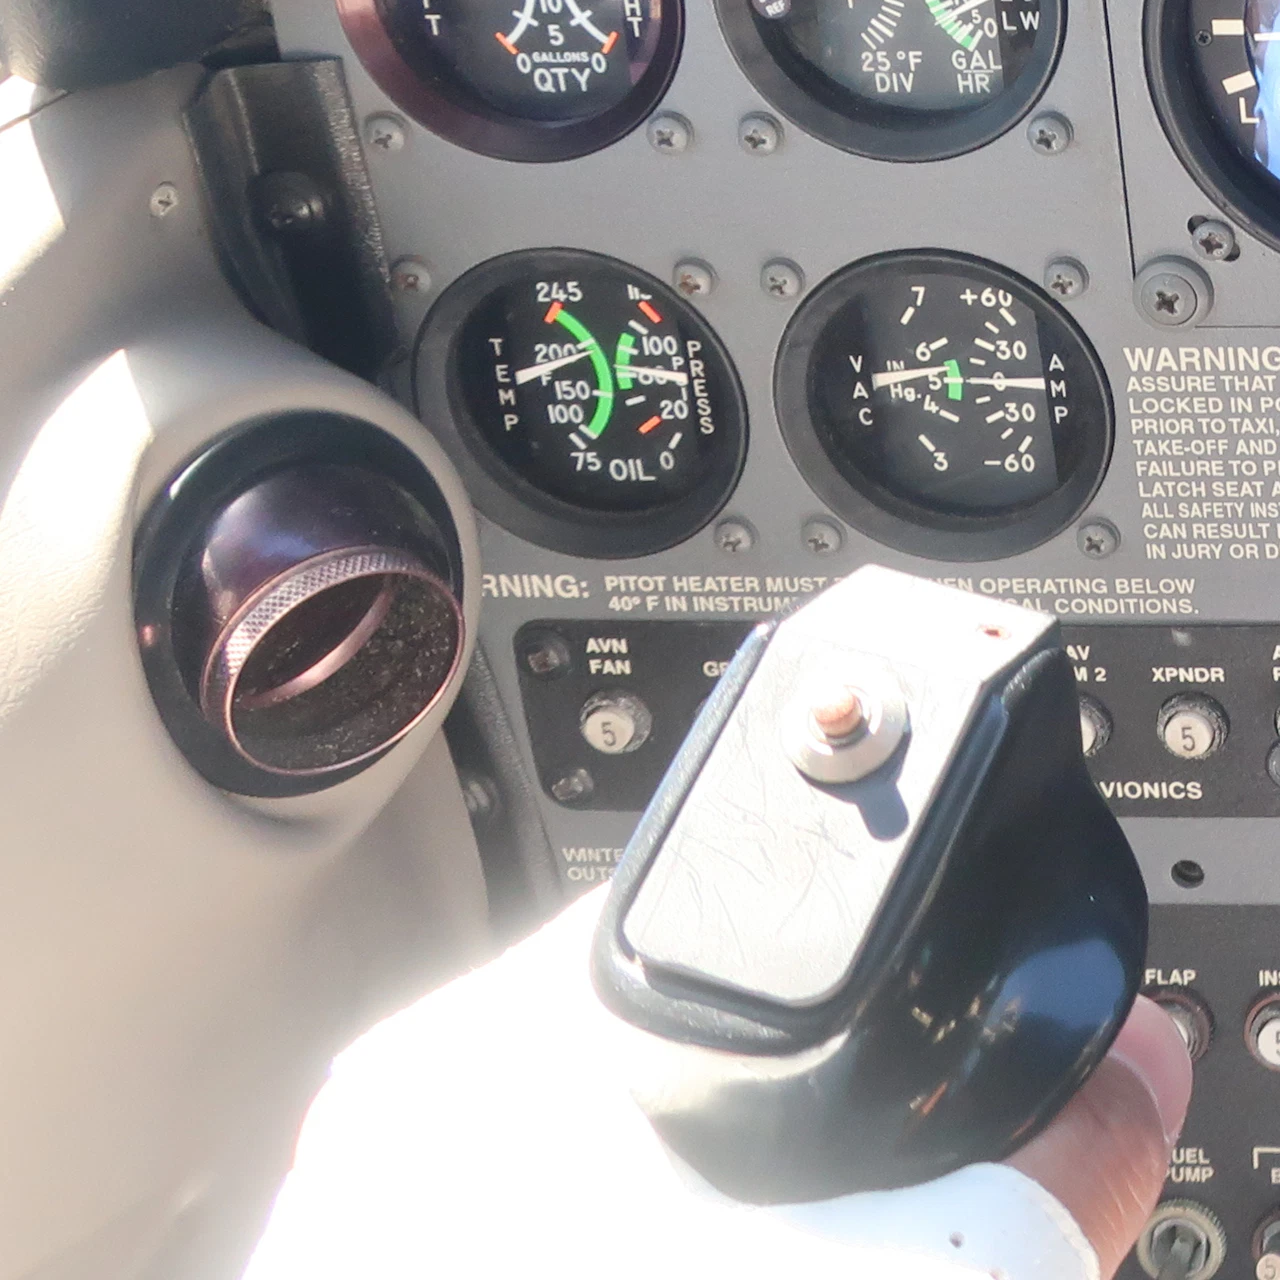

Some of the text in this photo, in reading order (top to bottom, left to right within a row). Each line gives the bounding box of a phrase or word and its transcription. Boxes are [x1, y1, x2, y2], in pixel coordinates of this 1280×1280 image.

[532, 52, 589, 63] GALLONS
[534, 68, 590, 92] QTY
[875, 72, 913, 92] DIV
[536, 281, 582, 302] 245
[1129, 397, 1223, 413] LOCKED
[1231, 397, 1252, 413] IN
[1133, 439, 1228, 455] TAKE-OFF
[1236, 439, 1276, 455] AND
[610, 459, 655, 481] OIL
[1144, 523, 1187, 539] CAN
[1193, 523, 1270, 538] RESULT
[605, 576, 760, 593] PITOT HEATER
[586, 638, 627, 653] AVN
[589, 659, 631, 674] FAN
[1152, 667, 1224, 682] XPNDR
[1145, 969, 1196, 985] FLAP
